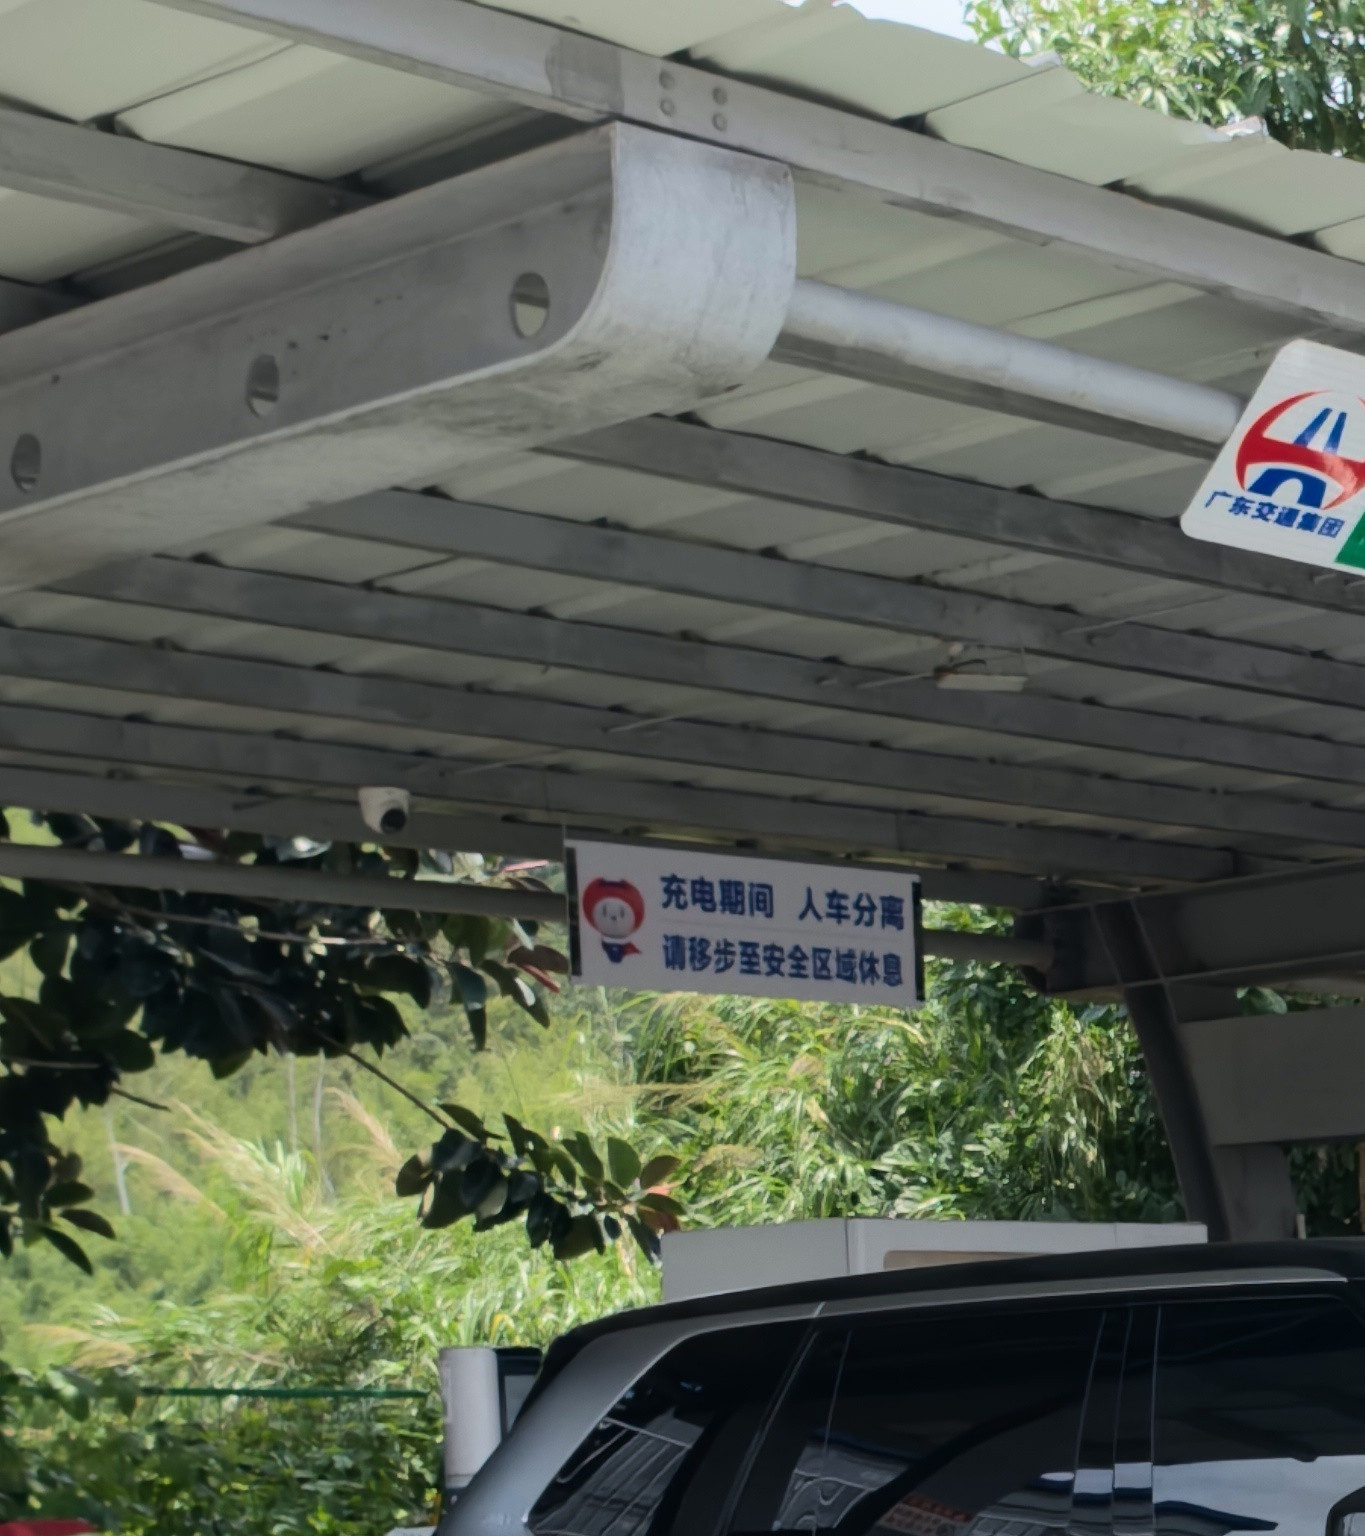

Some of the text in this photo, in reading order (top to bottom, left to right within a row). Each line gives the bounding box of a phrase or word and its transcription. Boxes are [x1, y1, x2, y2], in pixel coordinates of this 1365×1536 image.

[1205, 490, 1346, 539] 广东交通集团
[660, 873, 905, 930] 充电期间 人车分离
[662, 934, 904, 987] 请移步至安全区域休息
